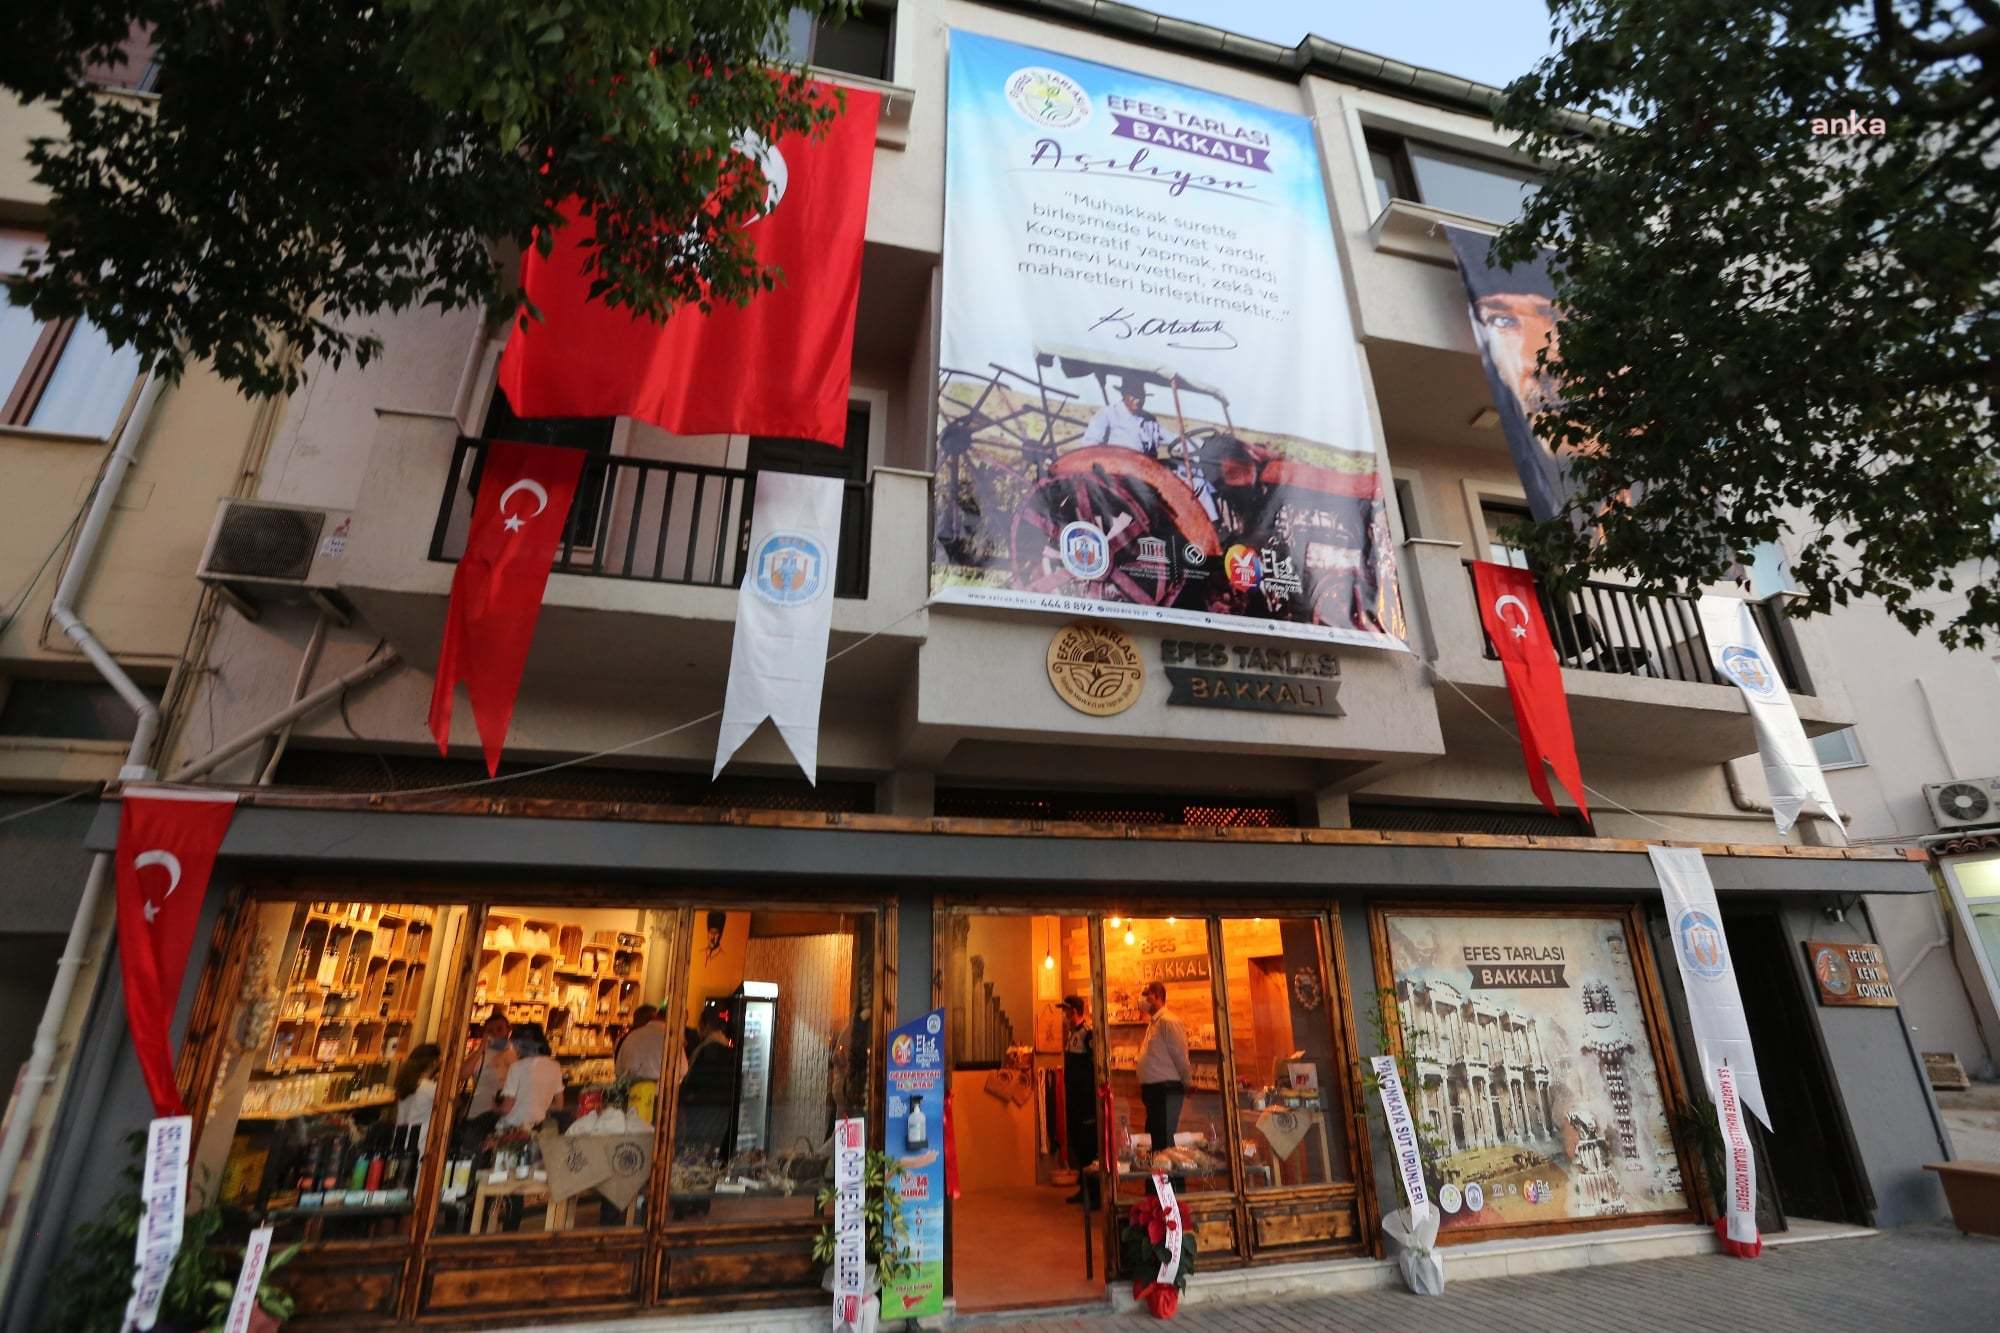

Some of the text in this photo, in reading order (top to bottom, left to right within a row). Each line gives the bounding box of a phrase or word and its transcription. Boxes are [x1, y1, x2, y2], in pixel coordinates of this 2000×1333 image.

[1107, 94, 1167, 120] EFES
[1174, 110, 1270, 147] TARLASI
[1131, 121, 1254, 165] BAKKALI
[1032, 202, 1141, 237] birleşmede
[1146, 226, 1209, 251] kuvvet
[1174, 217, 1238, 241] surette
[1026, 220, 1131, 252] Kooperatif
[1220, 262, 1278, 285] maddi
[1017, 260, 1134, 291] maharetleri
[1028, 242, 1101, 265] manevi
[1259, 287, 1279, 303] ve
[1040, 599, 1062, 610] 444
[1063, 600, 1071, 610] 8
[1073, 601, 1095, 613] 892
[1057, 632, 1078, 661] EFES
[1161, 639, 1341, 678] EFES TARLASI
[1191, 677, 1325, 708] BAKKALI
[1463, 946, 1565, 961] EFES TARLASI
[1481, 968, 1557, 985] BAKKALI
[841, 1152, 859, 1178] CHP
